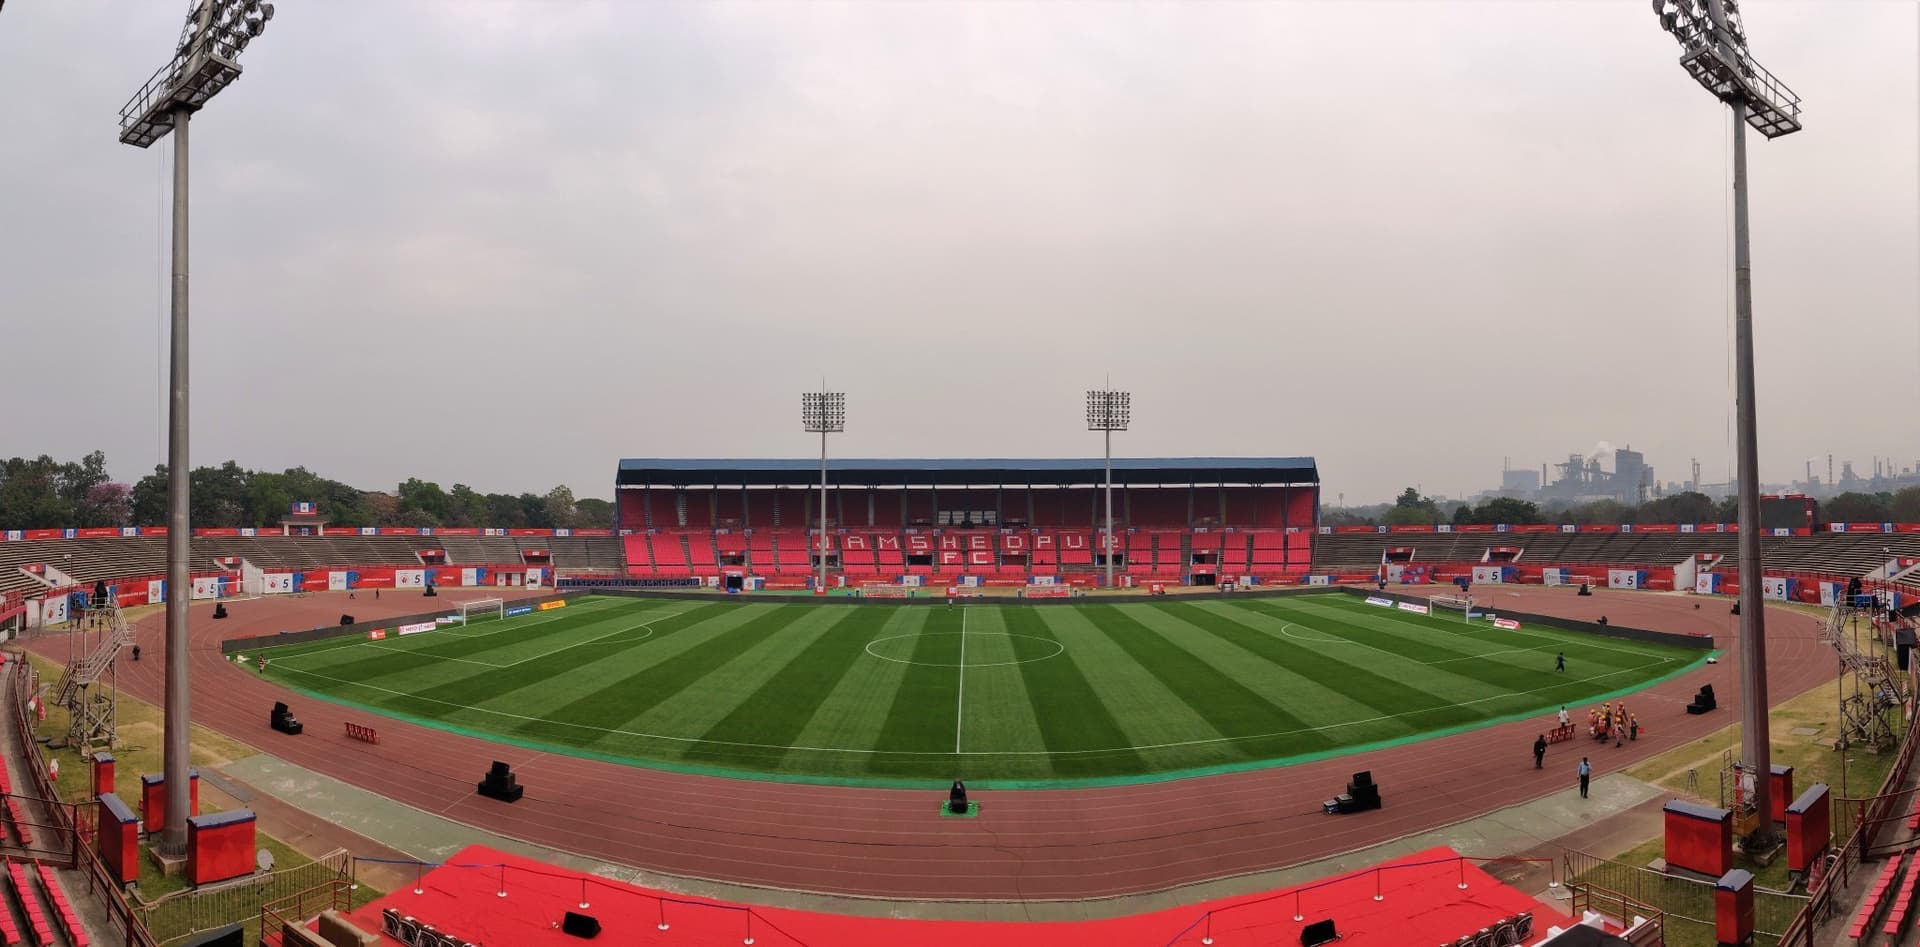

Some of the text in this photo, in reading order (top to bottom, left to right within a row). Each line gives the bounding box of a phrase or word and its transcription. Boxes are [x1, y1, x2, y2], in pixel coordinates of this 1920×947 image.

[816, 535, 1119, 549] JAMSHEDPUR
[943, 551, 988, 564] FC
[414, 574, 421, 584] 5
[1491, 571, 1498, 581] 5
[1626, 575, 1634, 586] 5
[282, 578, 289, 589] 5
[1777, 584, 1784, 595] 5
[58, 603, 65, 617] 5
